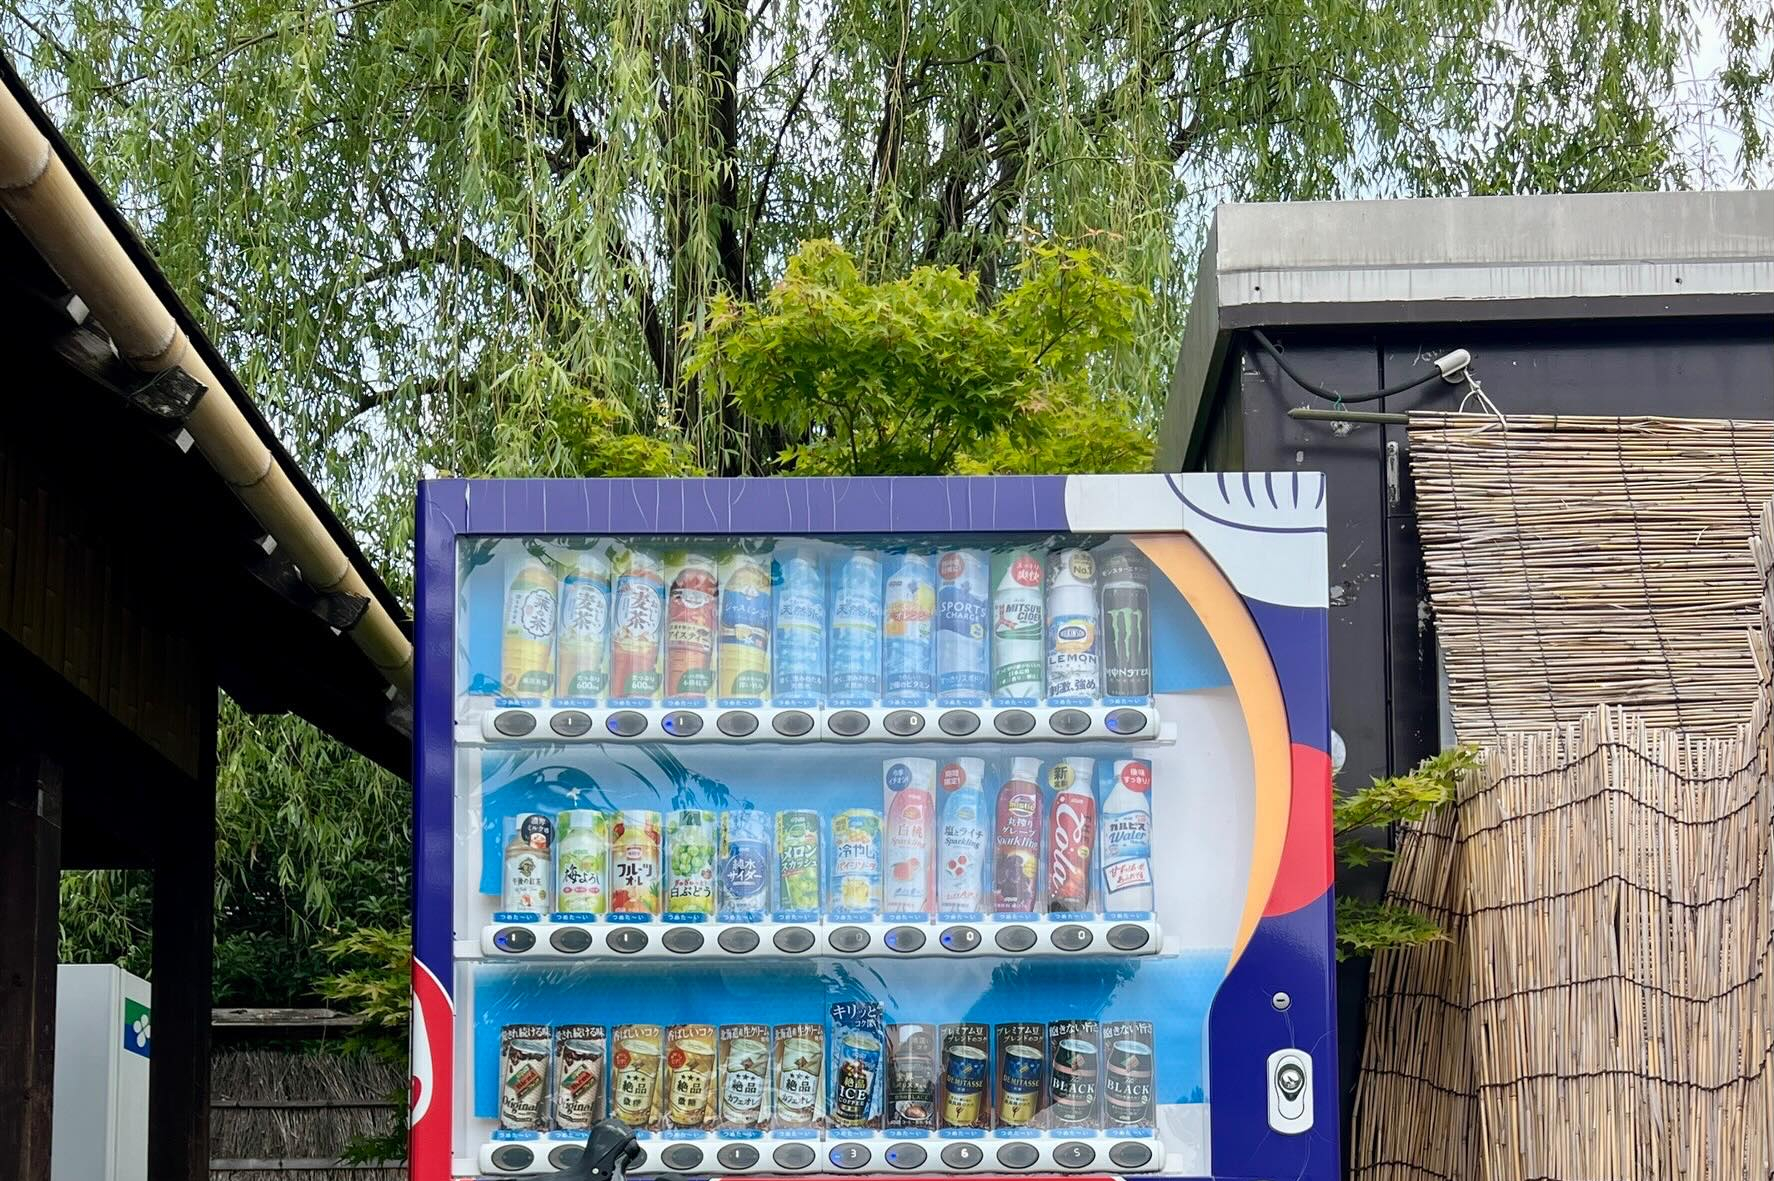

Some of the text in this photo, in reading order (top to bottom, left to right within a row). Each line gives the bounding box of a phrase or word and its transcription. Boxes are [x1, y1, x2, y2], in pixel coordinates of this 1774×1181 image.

[626, 590, 650, 630] 麦茶
[941, 601, 987, 618] SPORTS
[1049, 653, 1098, 665] LEMON
[1053, 765, 1068, 780] 新
[944, 826, 984, 839] 塩とライチ
[1109, 822, 1147, 832] カルピス
[1109, 831, 1147, 845] Water
[783, 845, 817, 861] メロン
[838, 845, 876, 859] 冷やし
[617, 864, 653, 878] フルーツ
[727, 869, 762, 880] サイダー
[670, 886, 711, 898] 白ぶどう
[832, 1004, 878, 1020] キリッと
[622, 1080, 648, 1095] 絶品
[677, 1079, 702, 1095] 絶品
[731, 1079, 757, 1095] 絶品
[785, 1079, 811, 1094] 絶品
[1003, 1074, 1040, 1088] DEMITASSE
[1052, 1078, 1095, 1094] BLACK
[1106, 1079, 1150, 1095] BLACK
[727, 1093, 757, 1107] カフェオレ
[839, 1085, 868, 1101] ICE
